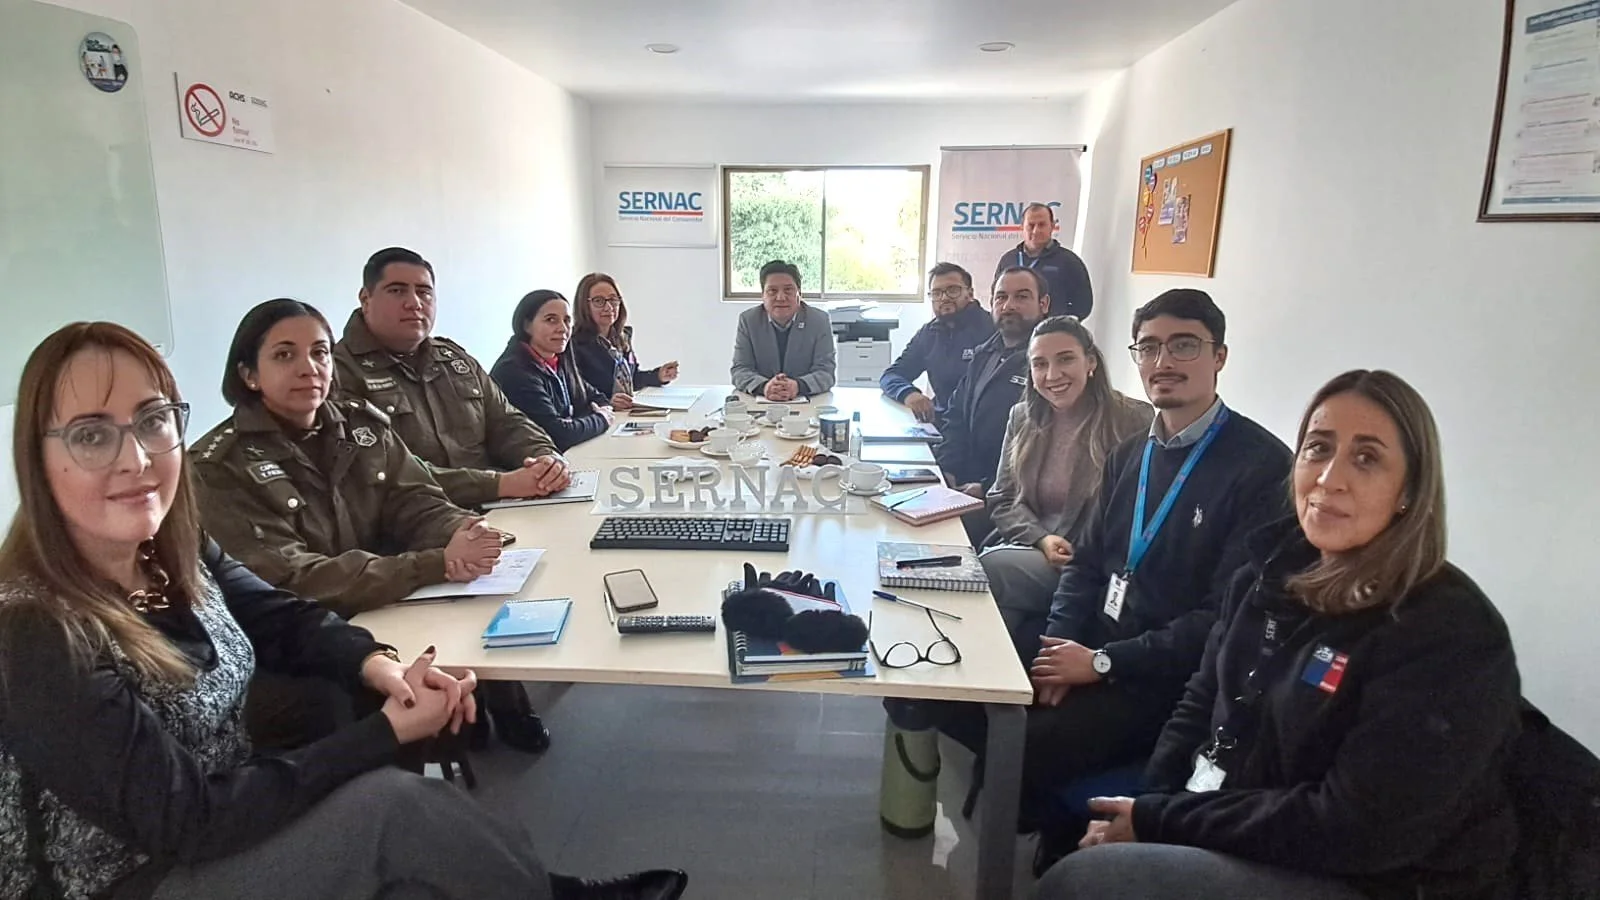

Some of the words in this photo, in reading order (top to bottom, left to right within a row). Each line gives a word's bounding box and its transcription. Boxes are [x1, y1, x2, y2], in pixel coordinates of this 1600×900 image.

[618, 191, 702, 211] SERNAC
[951, 232, 978, 240] Servicio
[978, 232, 1007, 240] Nacional
[1007, 232, 1019, 240] del
[609, 464, 850, 510] SERNAC
